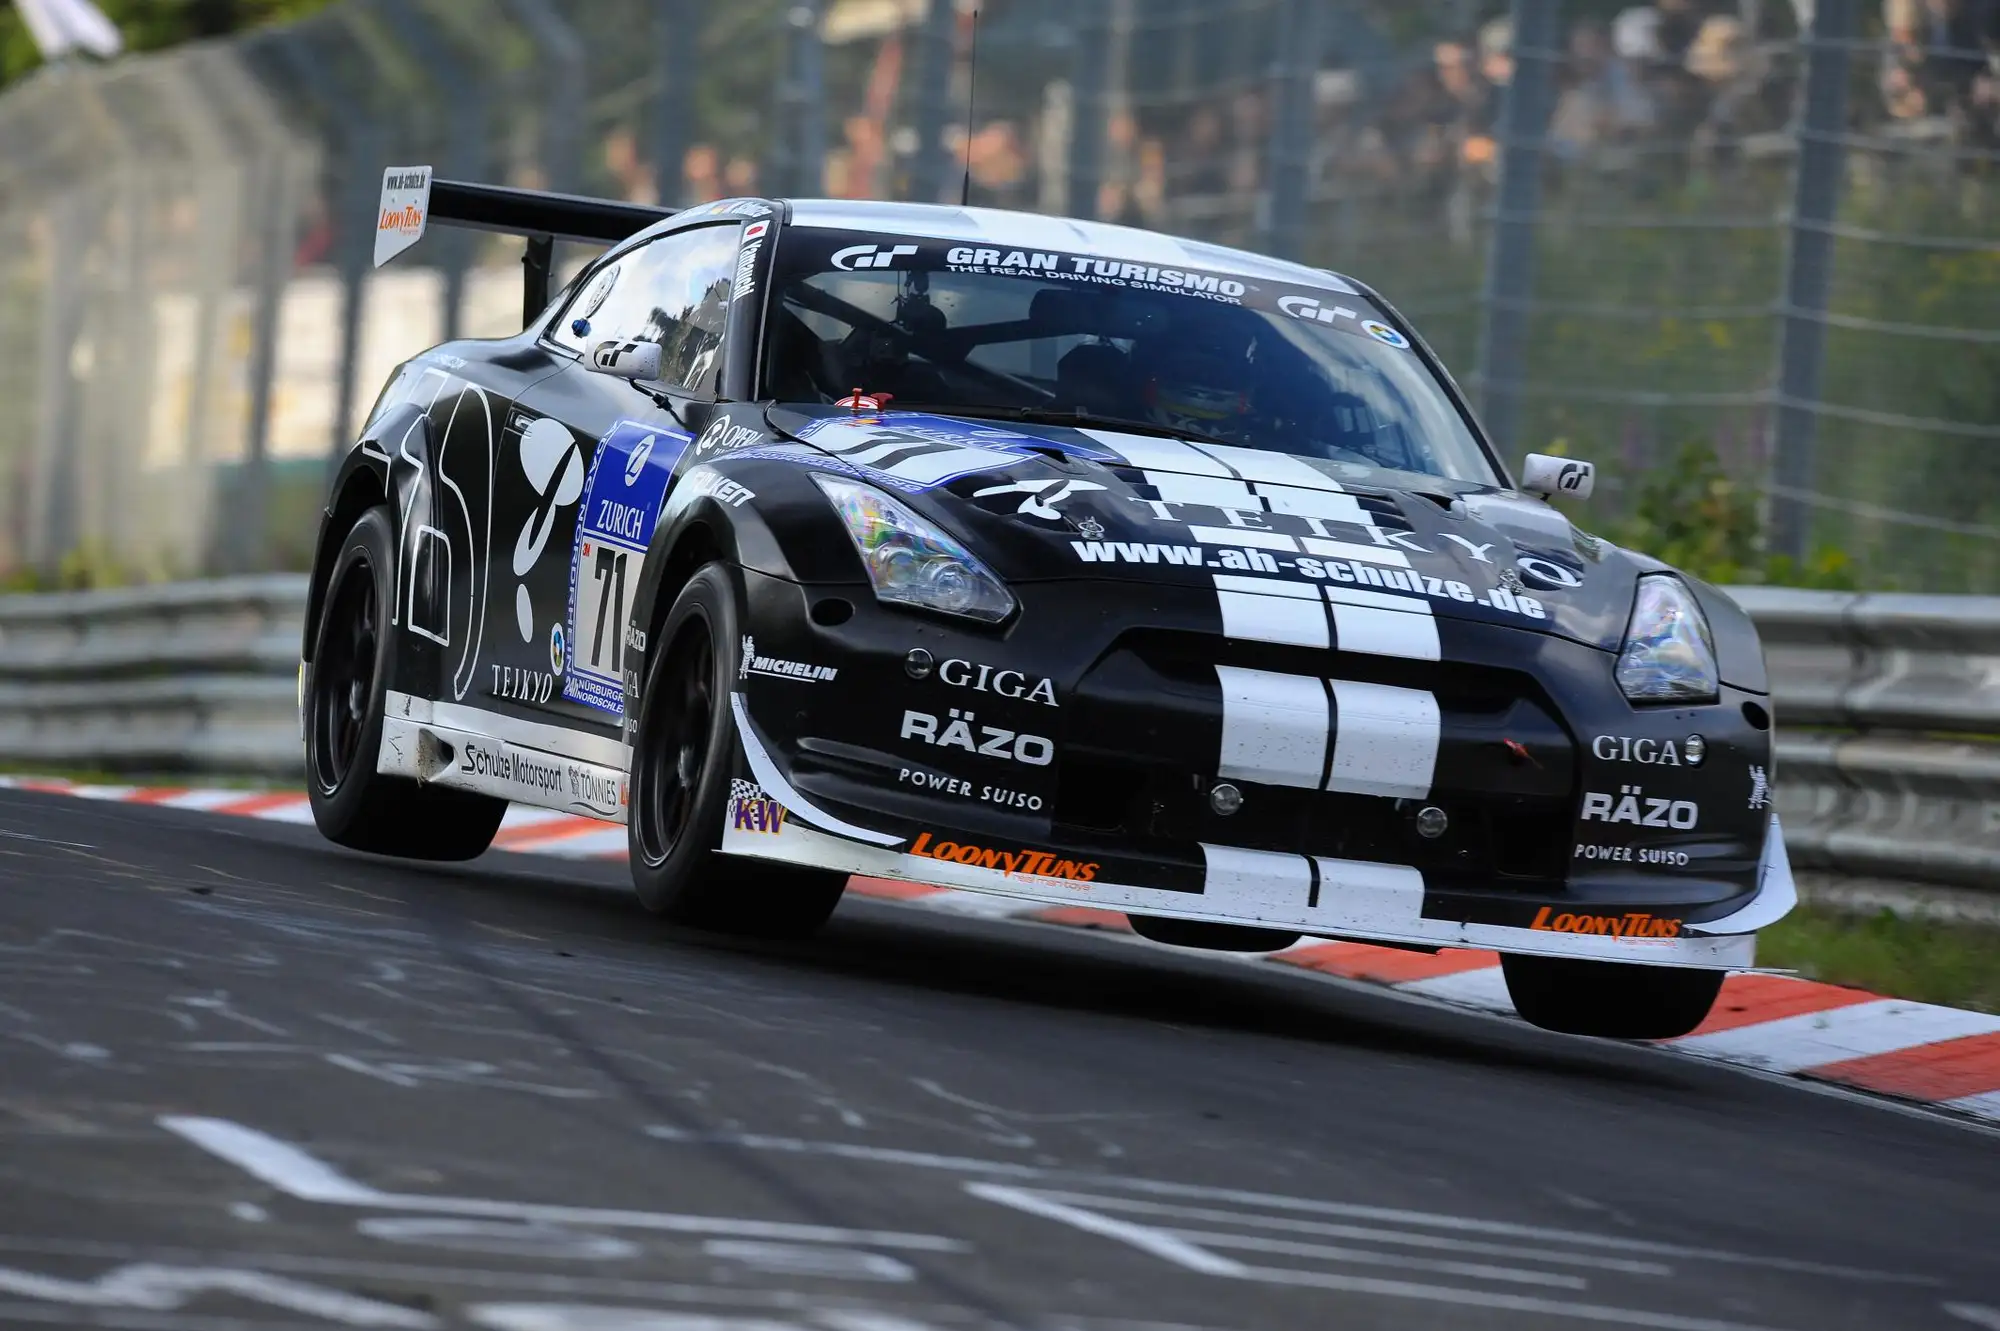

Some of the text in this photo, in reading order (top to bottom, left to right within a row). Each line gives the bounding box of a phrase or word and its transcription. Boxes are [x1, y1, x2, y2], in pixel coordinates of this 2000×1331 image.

[946, 247, 1245, 297] GRAN TURISMO
[946, 264, 1242, 306] THE REAL DRIVING SIMULATOR
[597, 499, 644, 540] ZURICH
[1127, 496, 1584, 588] TEIKYO
[1070, 541, 1546, 620] www.ah-schulze.de
[591, 546, 627, 673] 71
[492, 664, 553, 704] TEIKYO
[753, 656, 838, 680] MICHELIN
[939, 659, 1060, 707] GIGA
[901, 708, 1054, 766] RÄZO
[1592, 735, 1682, 766] GIGA
[461, 743, 511, 780] Schulze
[512, 752, 562, 796] Motorsport
[899, 768, 1042, 810] POWER SUISO
[734, 798, 784, 834] KW
[1581, 785, 1698, 830] RÄZO
[1574, 844, 1689, 866] POWER SUISO
